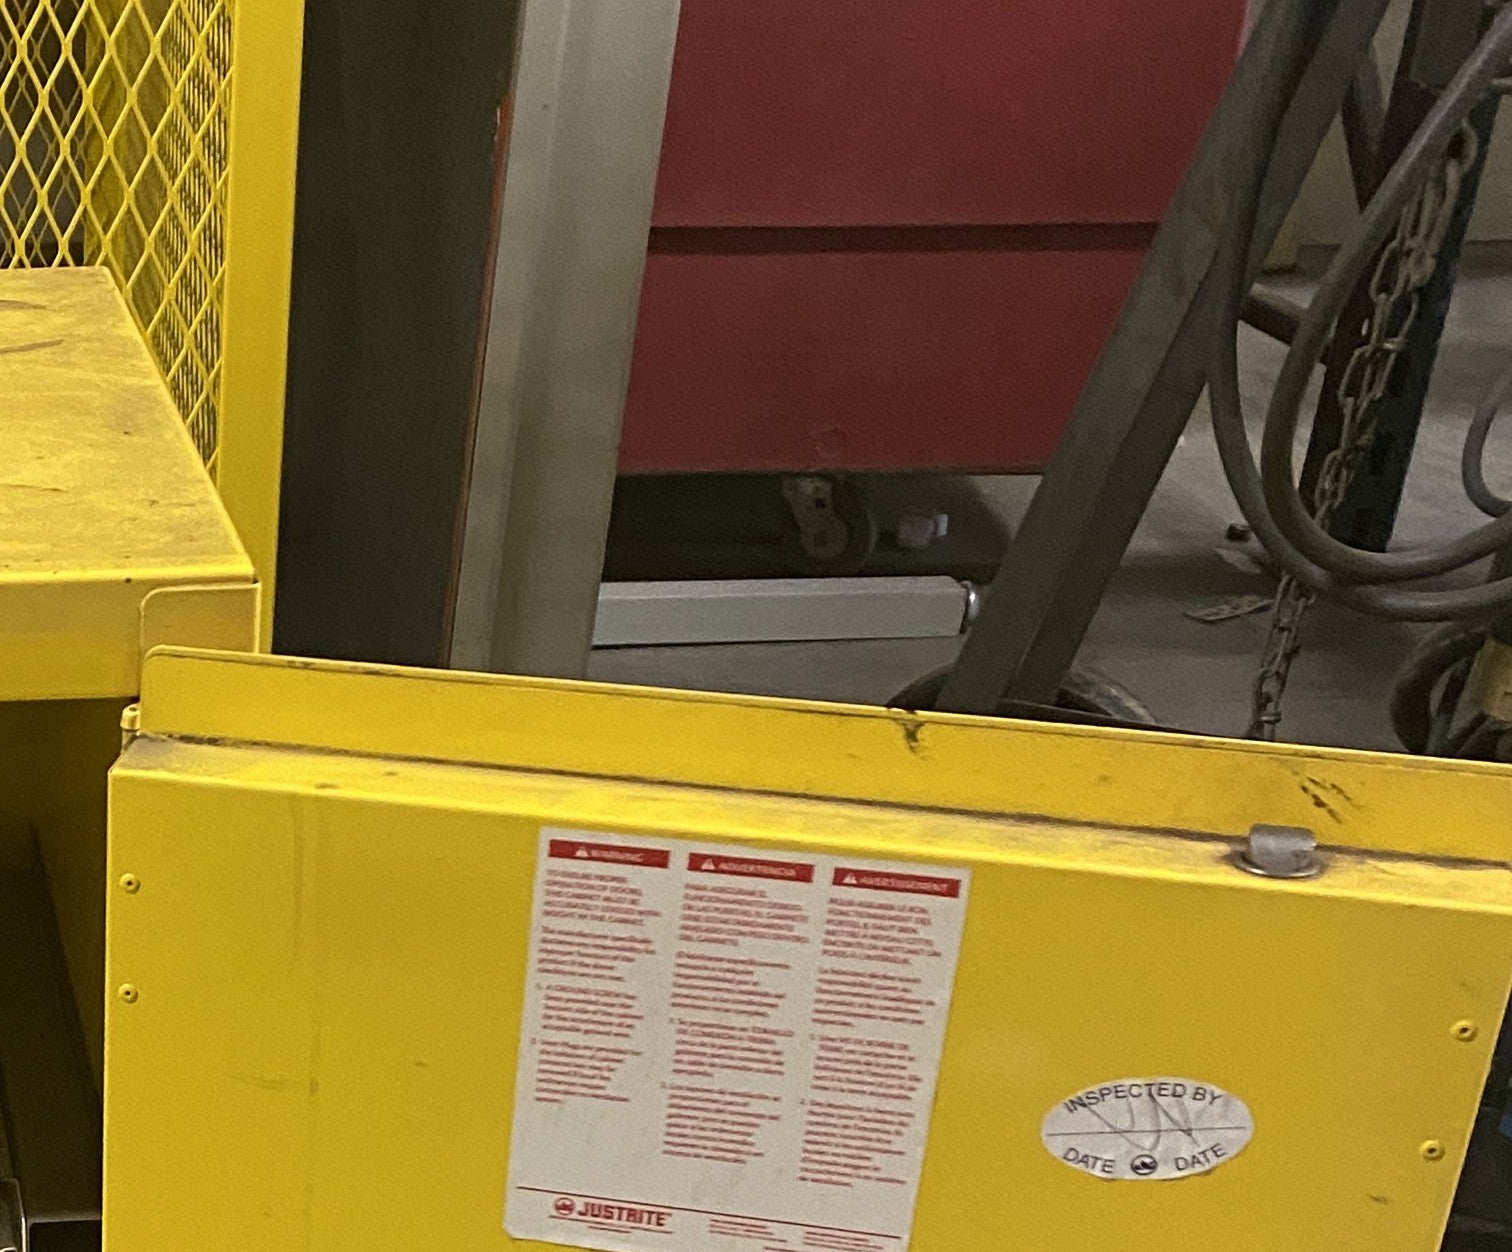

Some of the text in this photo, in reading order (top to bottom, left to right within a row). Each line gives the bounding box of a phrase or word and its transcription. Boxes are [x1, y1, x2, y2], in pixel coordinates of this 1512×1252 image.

[1063, 1082, 1223, 1114] INSPECTED BY
[1062, 1147, 1116, 1174] DATE
[1174, 1143, 1227, 1171] DATE
[577, 1201, 667, 1227] JUSTRITE
